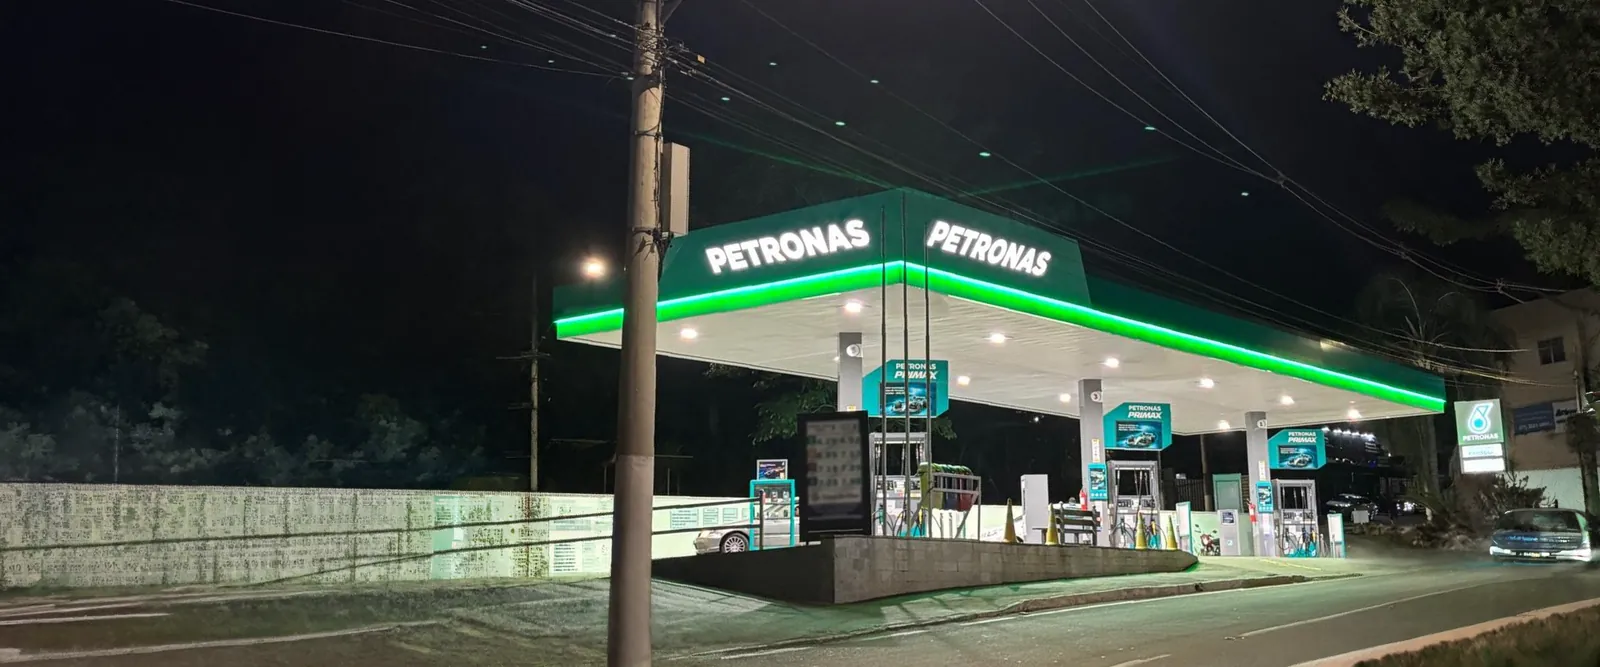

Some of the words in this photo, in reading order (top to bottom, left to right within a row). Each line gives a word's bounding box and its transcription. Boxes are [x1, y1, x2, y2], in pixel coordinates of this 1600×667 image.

[705, 219, 870, 275] PETRONAS
[926, 220, 1052, 277] PETRONAS
[1127, 411, 1163, 419] PRIMAX
[1462, 433, 1499, 442] PETRONAS
